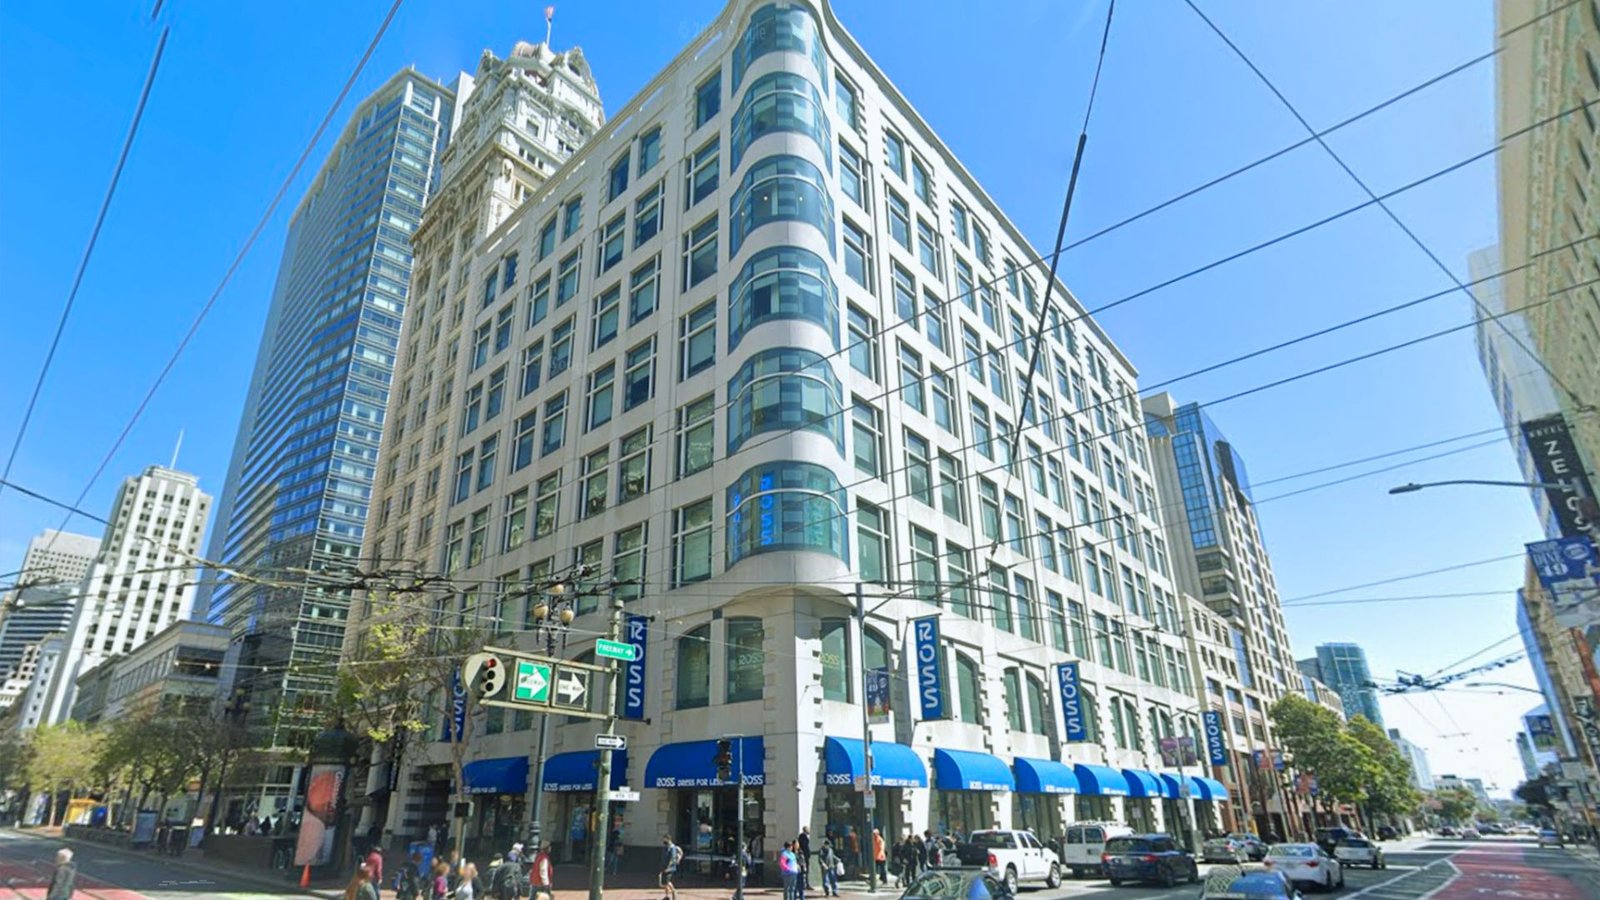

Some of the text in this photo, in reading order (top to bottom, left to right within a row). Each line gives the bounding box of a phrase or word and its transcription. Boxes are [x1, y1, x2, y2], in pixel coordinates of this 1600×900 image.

[760, 477, 774, 545] ROSS
[628, 621, 644, 707] ROSS
[918, 622, 939, 709] ROSS
[1061, 667, 1081, 733] ROSS
[1206, 713, 1223, 760] ROSS
[656, 777, 676, 787] ROSS
[677, 778, 695, 787] DRESS
[696, 778, 708, 787] FOR
[742, 775, 764, 785] ROSS
[826, 773, 851, 785] ROSS
